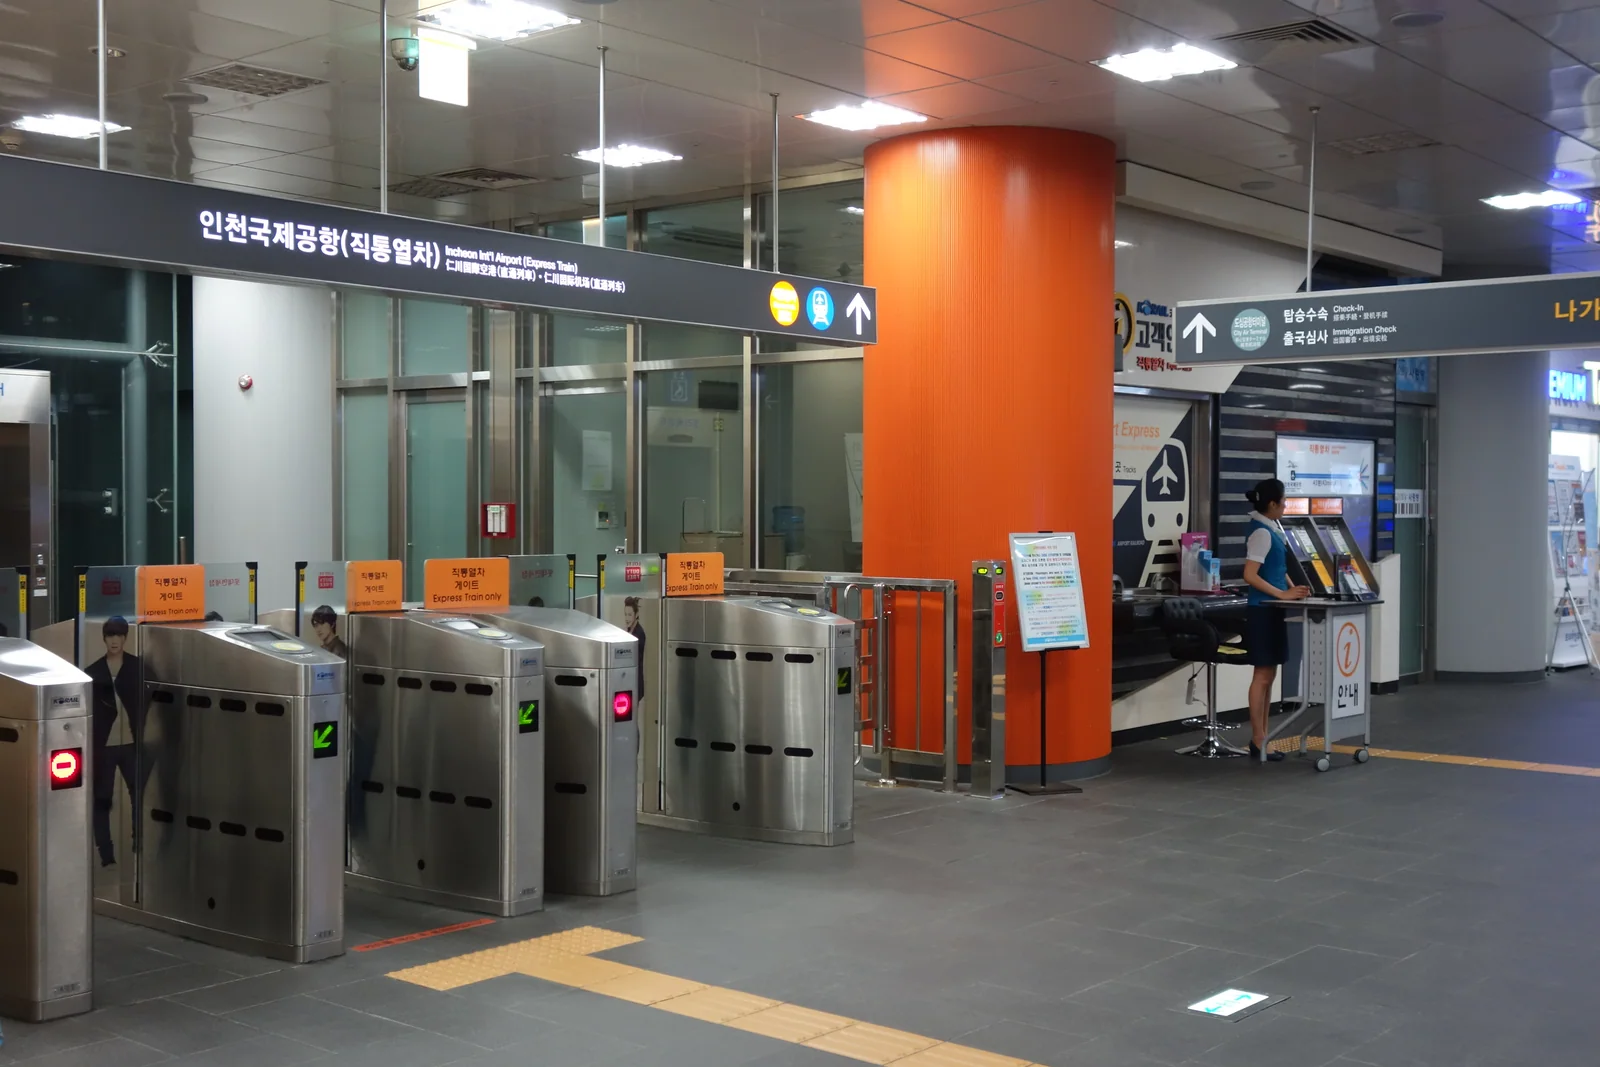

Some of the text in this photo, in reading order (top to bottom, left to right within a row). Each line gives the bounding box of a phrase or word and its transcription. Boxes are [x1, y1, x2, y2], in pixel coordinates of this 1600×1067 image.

[200, 210, 440, 269] 인천국제공항(직통열차)
[445, 245, 478, 259] Incheon
[495, 252, 522, 265] Airport
[523, 256, 556, 270] (Express
[557, 260, 578, 275] Train)
[1333, 304, 1364, 313] Check-In
[1283, 306, 1328, 323] 탑승수속
[1332, 325, 1397, 336] Immigration Check
[1283, 329, 1328, 346] 출국심사
[1121, 421, 1160, 439] Express
[680, 561, 705, 570] 직통열차
[451, 567, 485, 578] 직통열차
[681, 572, 700, 581] 게이트
[154, 578, 187, 587] 직통열차
[454, 580, 479, 590] 게이트
[689, 583, 704, 591] Train
[705, 582, 719, 590] only
[364, 584, 384, 593] 게이트
[159, 591, 183, 601] 게이트
[433, 592, 502, 603] Express Train only
[1337, 683, 1359, 708] 안내
